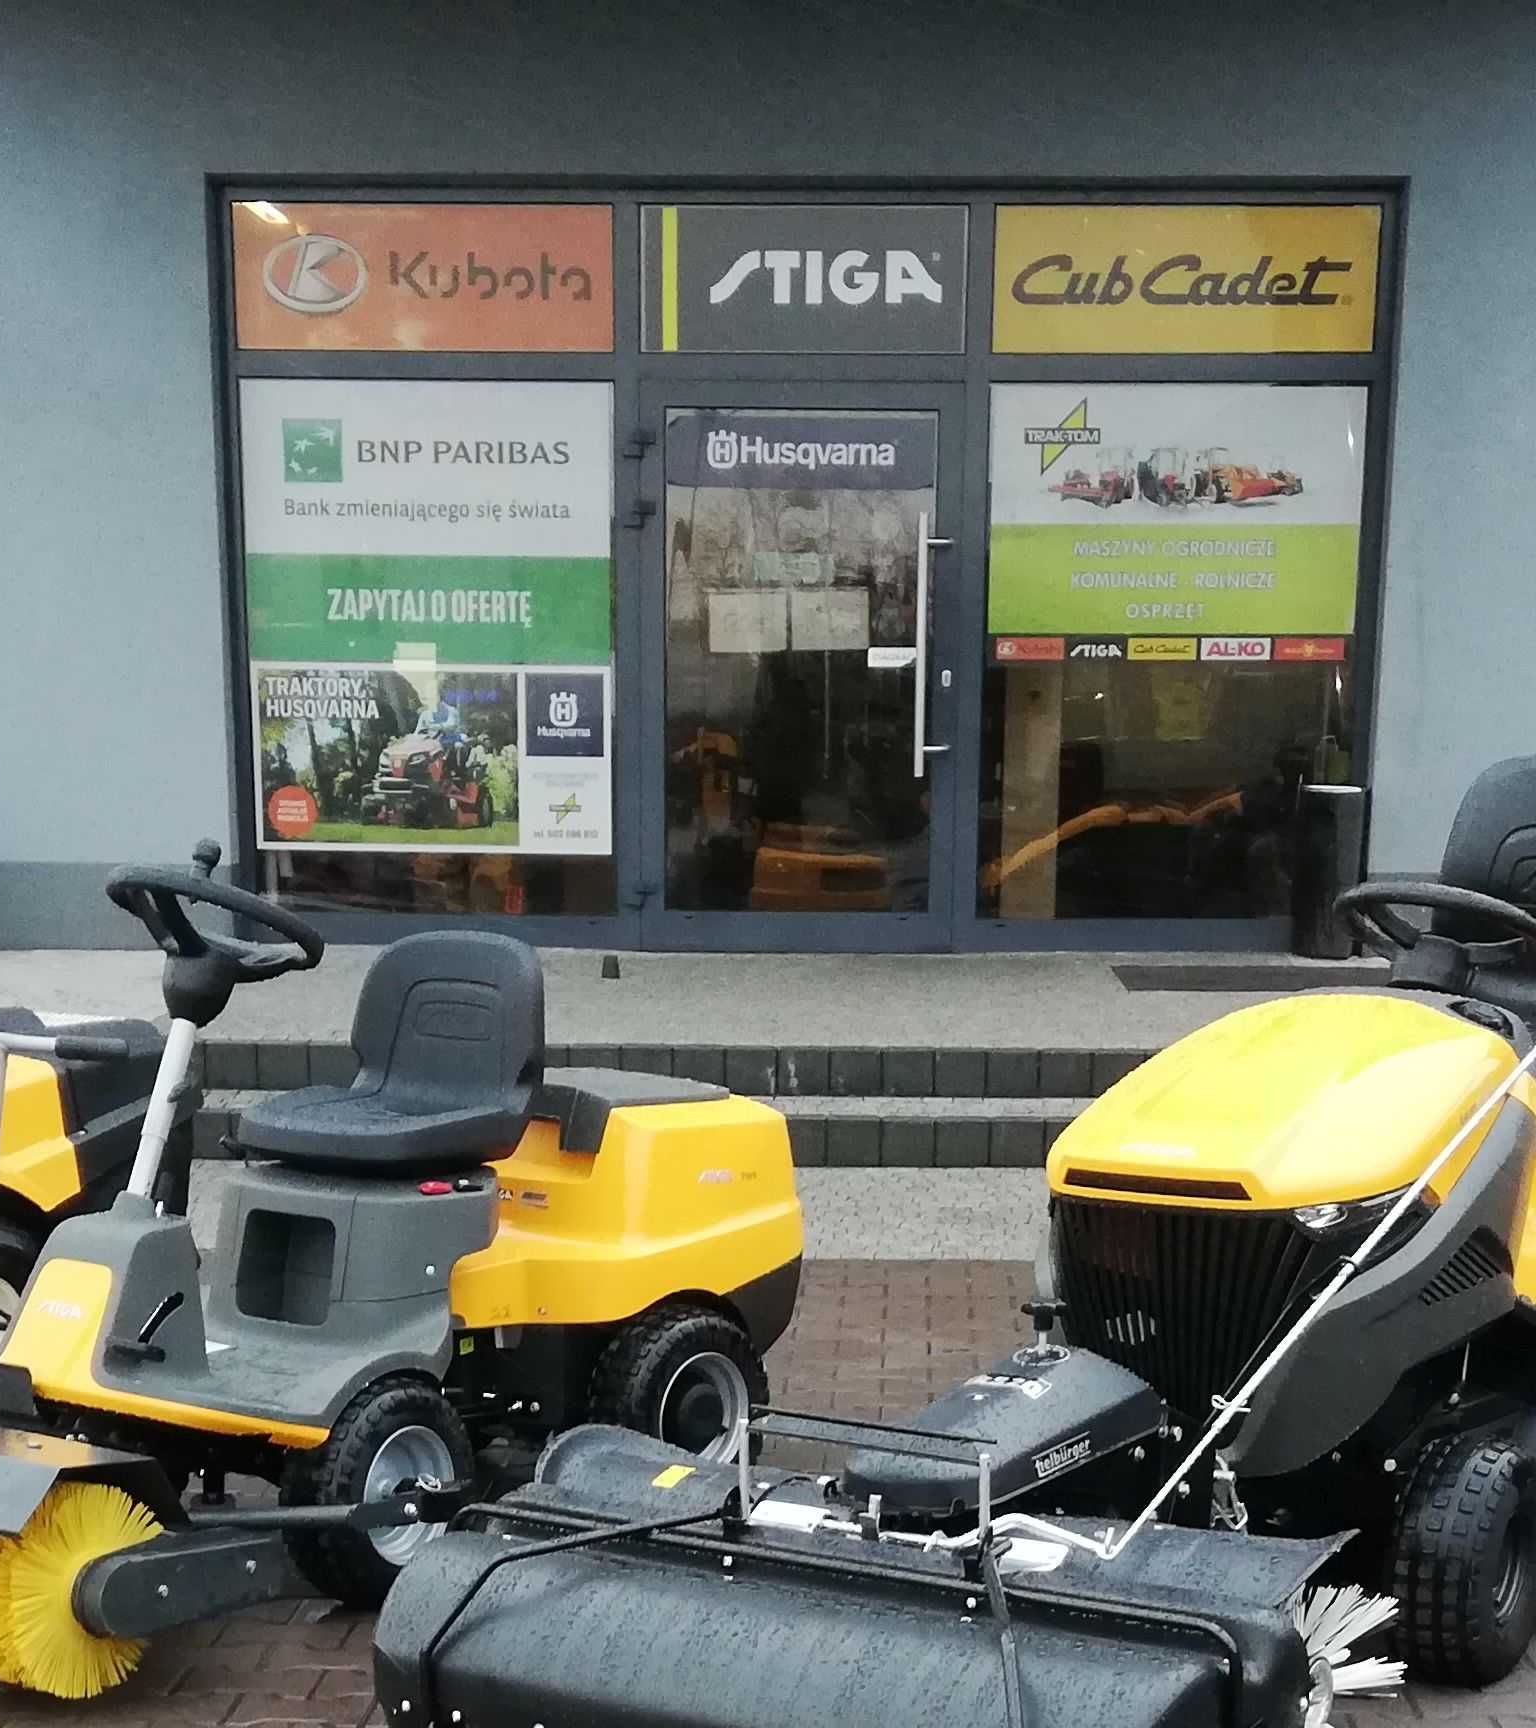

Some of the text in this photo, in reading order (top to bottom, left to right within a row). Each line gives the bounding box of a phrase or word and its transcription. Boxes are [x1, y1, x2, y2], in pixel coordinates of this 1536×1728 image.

[388, 250, 593, 301] Kubota
[709, 250, 943, 304] STIGA
[1011, 254, 1354, 305] Cub Cadet
[357, 439, 571, 465] BNP PARIBAS
[739, 436, 896, 469] Husqvarna
[284, 498, 571, 523] Bank zmieniającego się świata
[1073, 540, 1275, 556] MASZYNY OGRODNICZE
[1071, 572, 1177, 588] KOMUNALNE
[1194, 572, 1275, 588] ROLNICZE
[327, 588, 533, 628] ZAPYTAJ O OFERTĘ
[1069, 644, 1123, 658] STIGA
[1206, 641, 1266, 657] AL-KO
[265, 677, 362, 698] TRAKTORY
[266, 700, 380, 719] HUSQVARNA
[536, 726, 591, 739] Husqvarna
